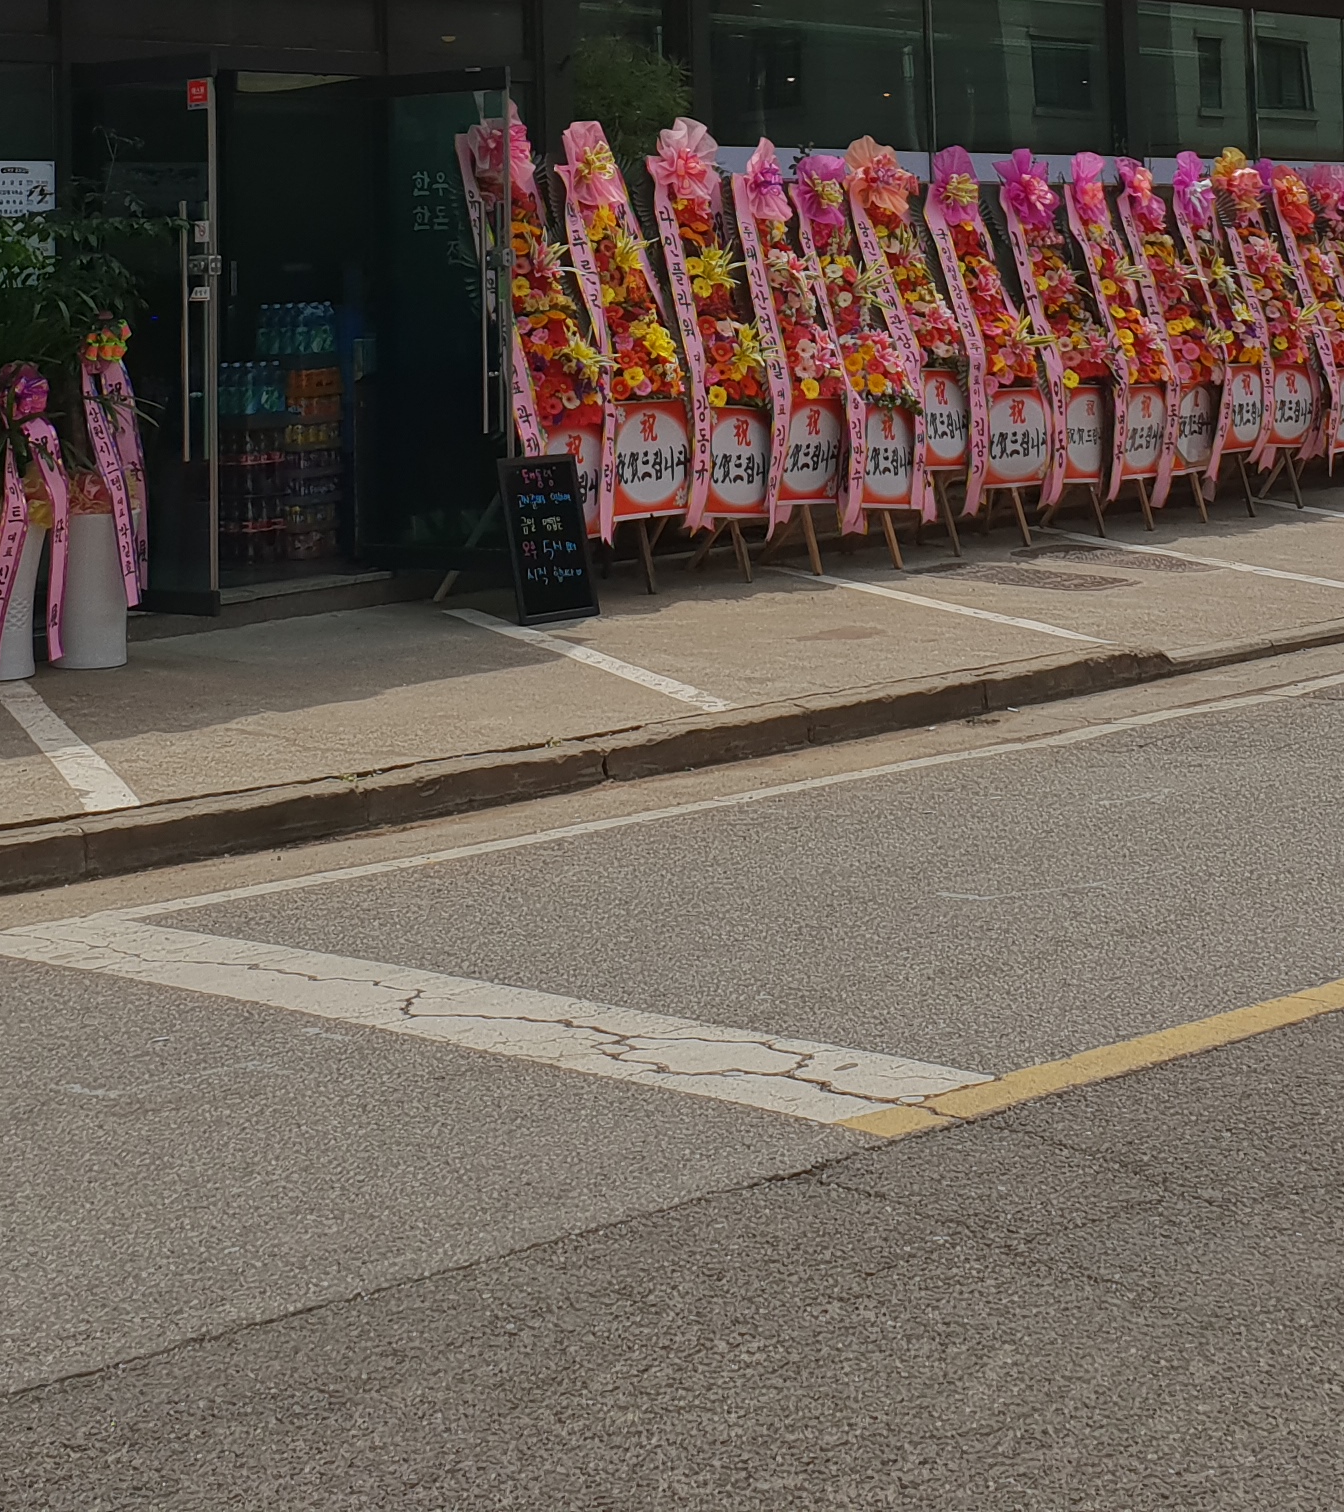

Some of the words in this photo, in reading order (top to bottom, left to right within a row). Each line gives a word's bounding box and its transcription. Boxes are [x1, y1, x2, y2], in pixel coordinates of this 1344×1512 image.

[412, 170, 450, 198] 한우
[412, 205, 450, 232] 한돈
[658, 204, 697, 343] 다인플라워
[694, 394, 710, 486] 강동규
[934, 379, 948, 405] 祝
[806, 407, 822, 436] 祝
[1010, 397, 1027, 425] 祝
[640, 412, 659, 442] 祝
[733, 417, 752, 447] 祝
[882, 411, 897, 441] 祝
[972, 416, 988, 479] 김상기
